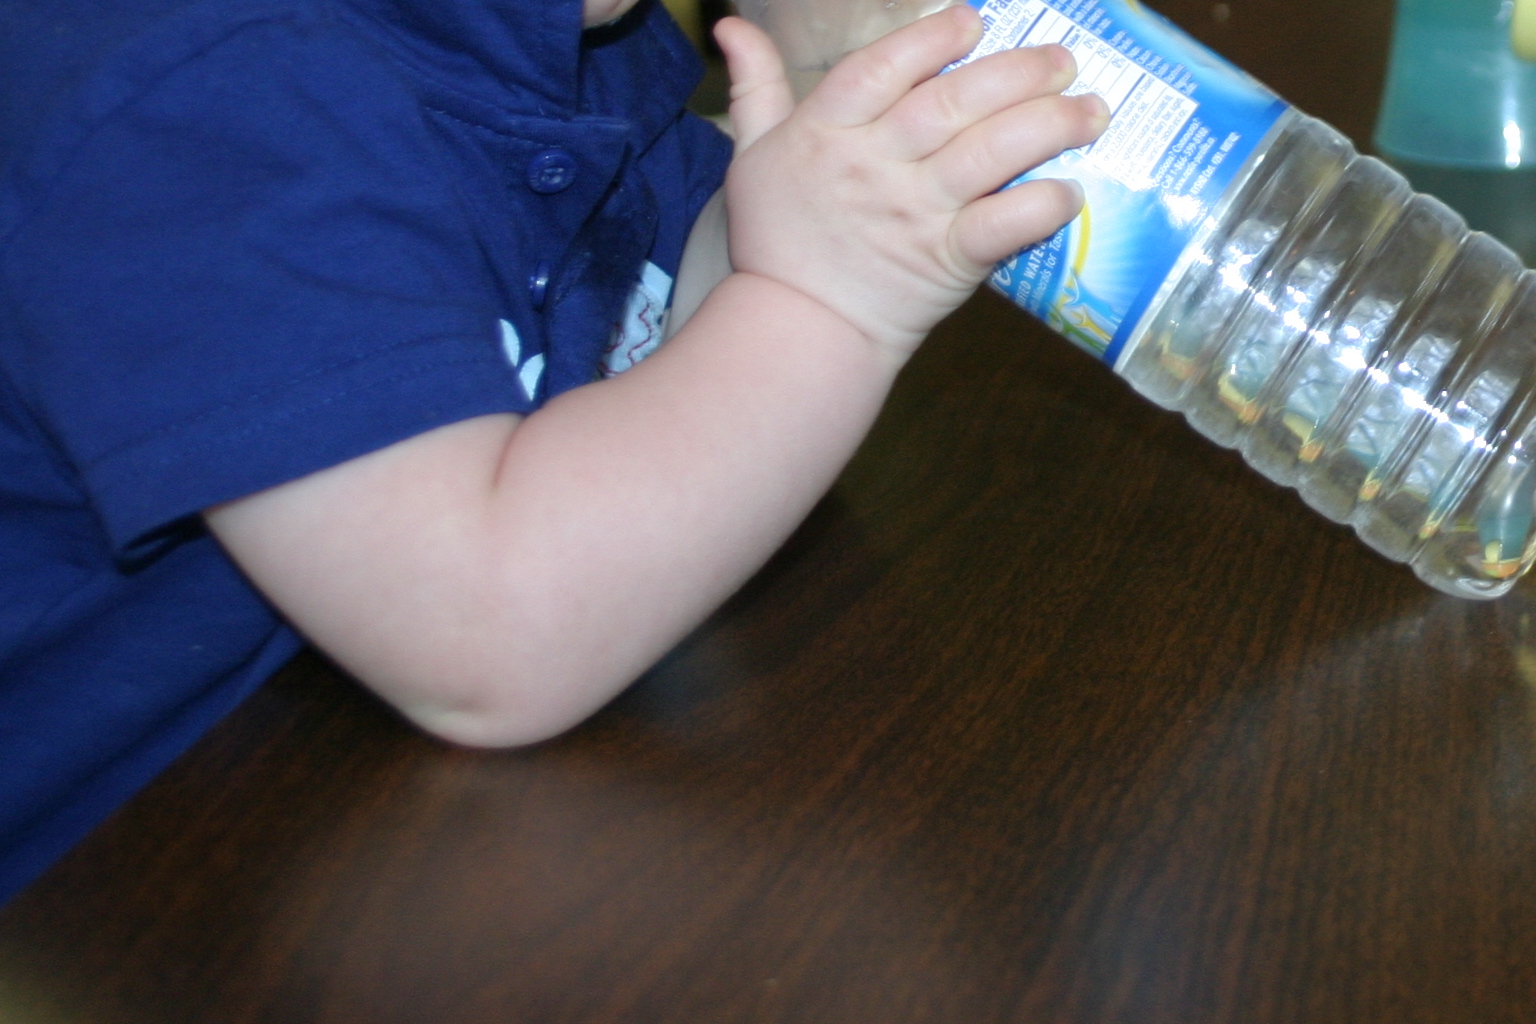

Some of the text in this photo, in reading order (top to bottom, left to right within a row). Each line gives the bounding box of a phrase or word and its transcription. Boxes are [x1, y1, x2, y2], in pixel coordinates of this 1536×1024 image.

[1006, 0, 1024, 19] (237
[999, 13, 1014, 27] OZ
[1001, 12, 1031, 46] Container
[1023, 6, 1035, 18] 2
[989, 30, 1001, 40] 8
[1081, 33, 1099, 50] 0%
[1094, 42, 1113, 60] 0%
[1109, 53, 1127, 70] 0%
[1108, 116, 1125, 135] Daily
[1118, 98, 1138, 120] Values
[1132, 89, 1145, 102] are
[1110, 129, 1129, 149] 2,000
[1170, 115, 1204, 155] Comments?
[1159, 173, 1175, 189] Call
[1042, 251, 1058, 268] for
